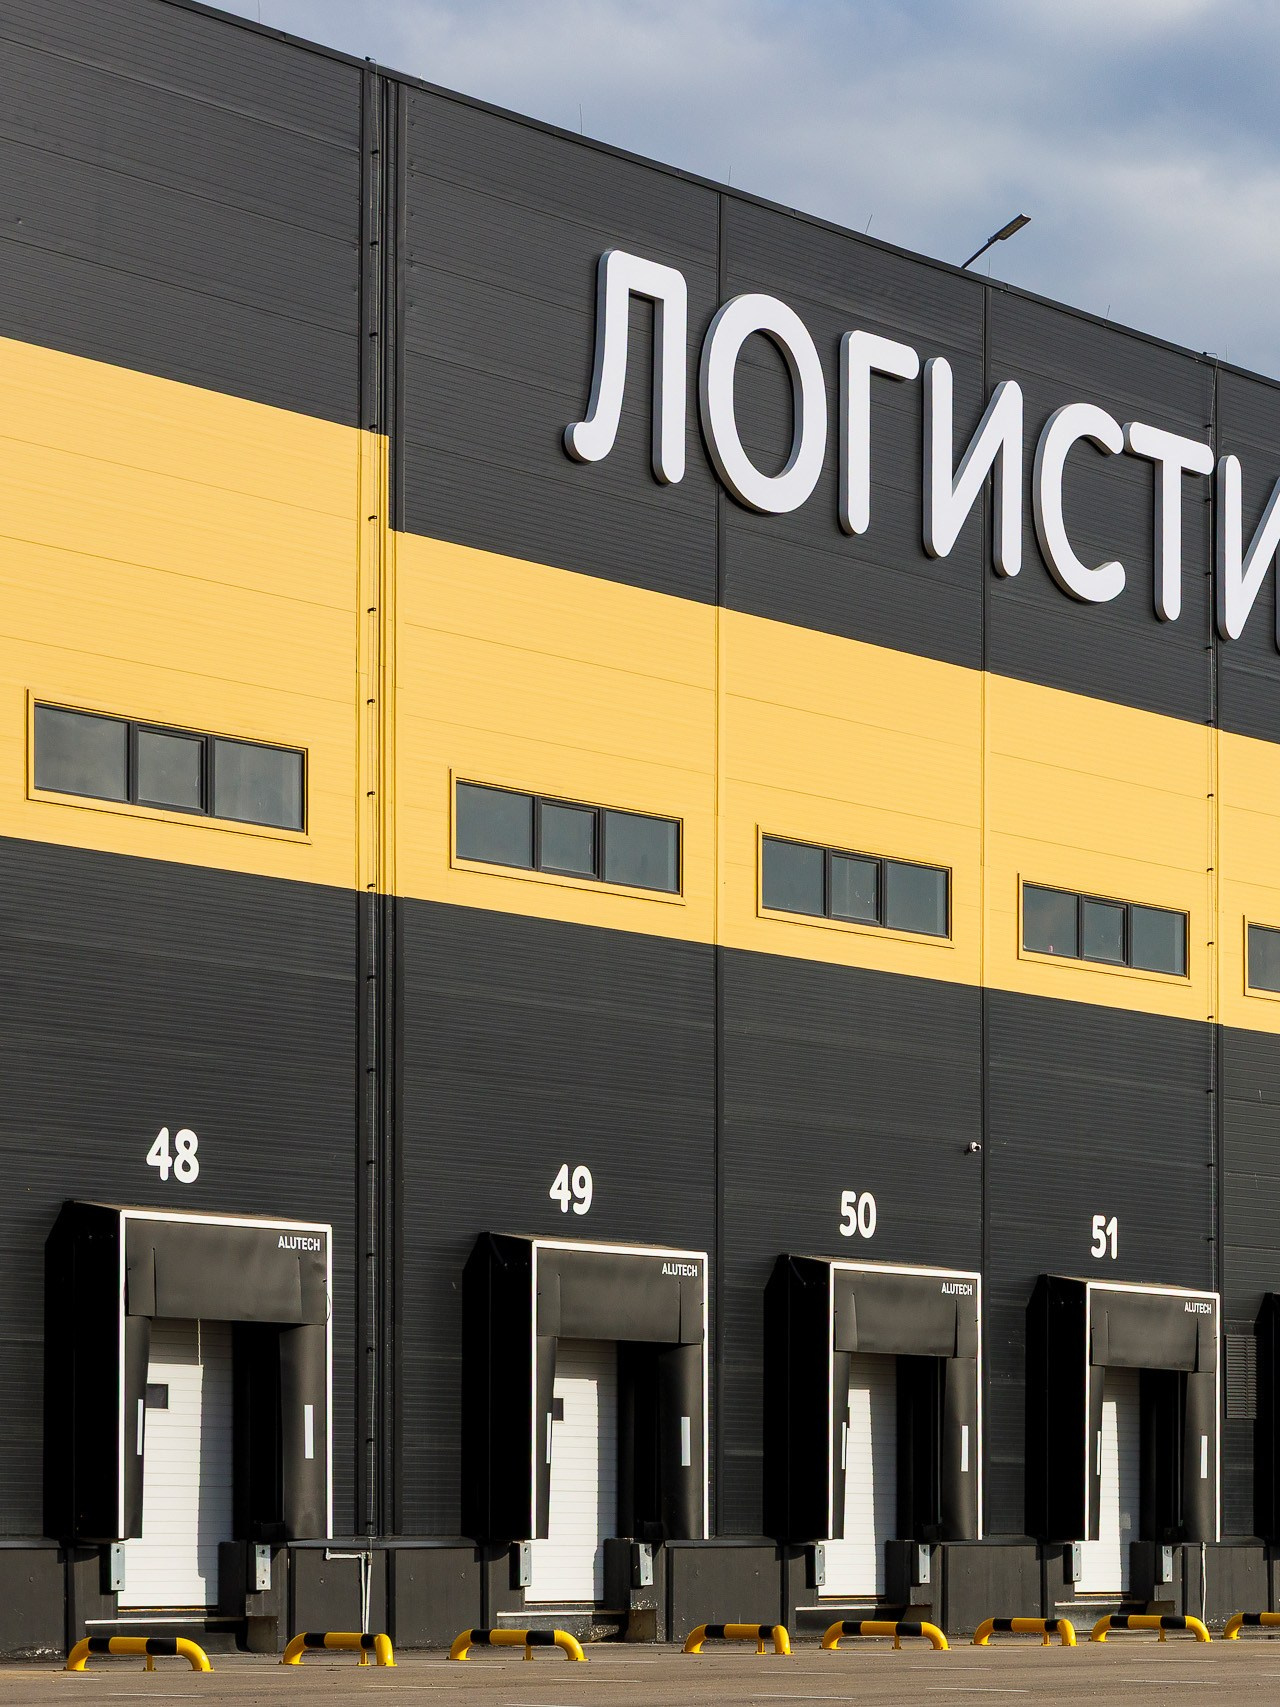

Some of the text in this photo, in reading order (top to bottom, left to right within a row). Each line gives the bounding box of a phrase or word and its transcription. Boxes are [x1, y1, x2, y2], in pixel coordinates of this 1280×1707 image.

[146, 1127, 199, 1183] 48
[549, 1164, 592, 1215] 49
[840, 1191, 876, 1238] 50
[278, 1236, 320, 1251] ALUTECH
[1091, 1215, 1117, 1259] 51
[662, 1263, 697, 1276] ALUTECH
[942, 1283, 972, 1295] ALUTECH
[1185, 1302, 1211, 1314] ALUTECH
